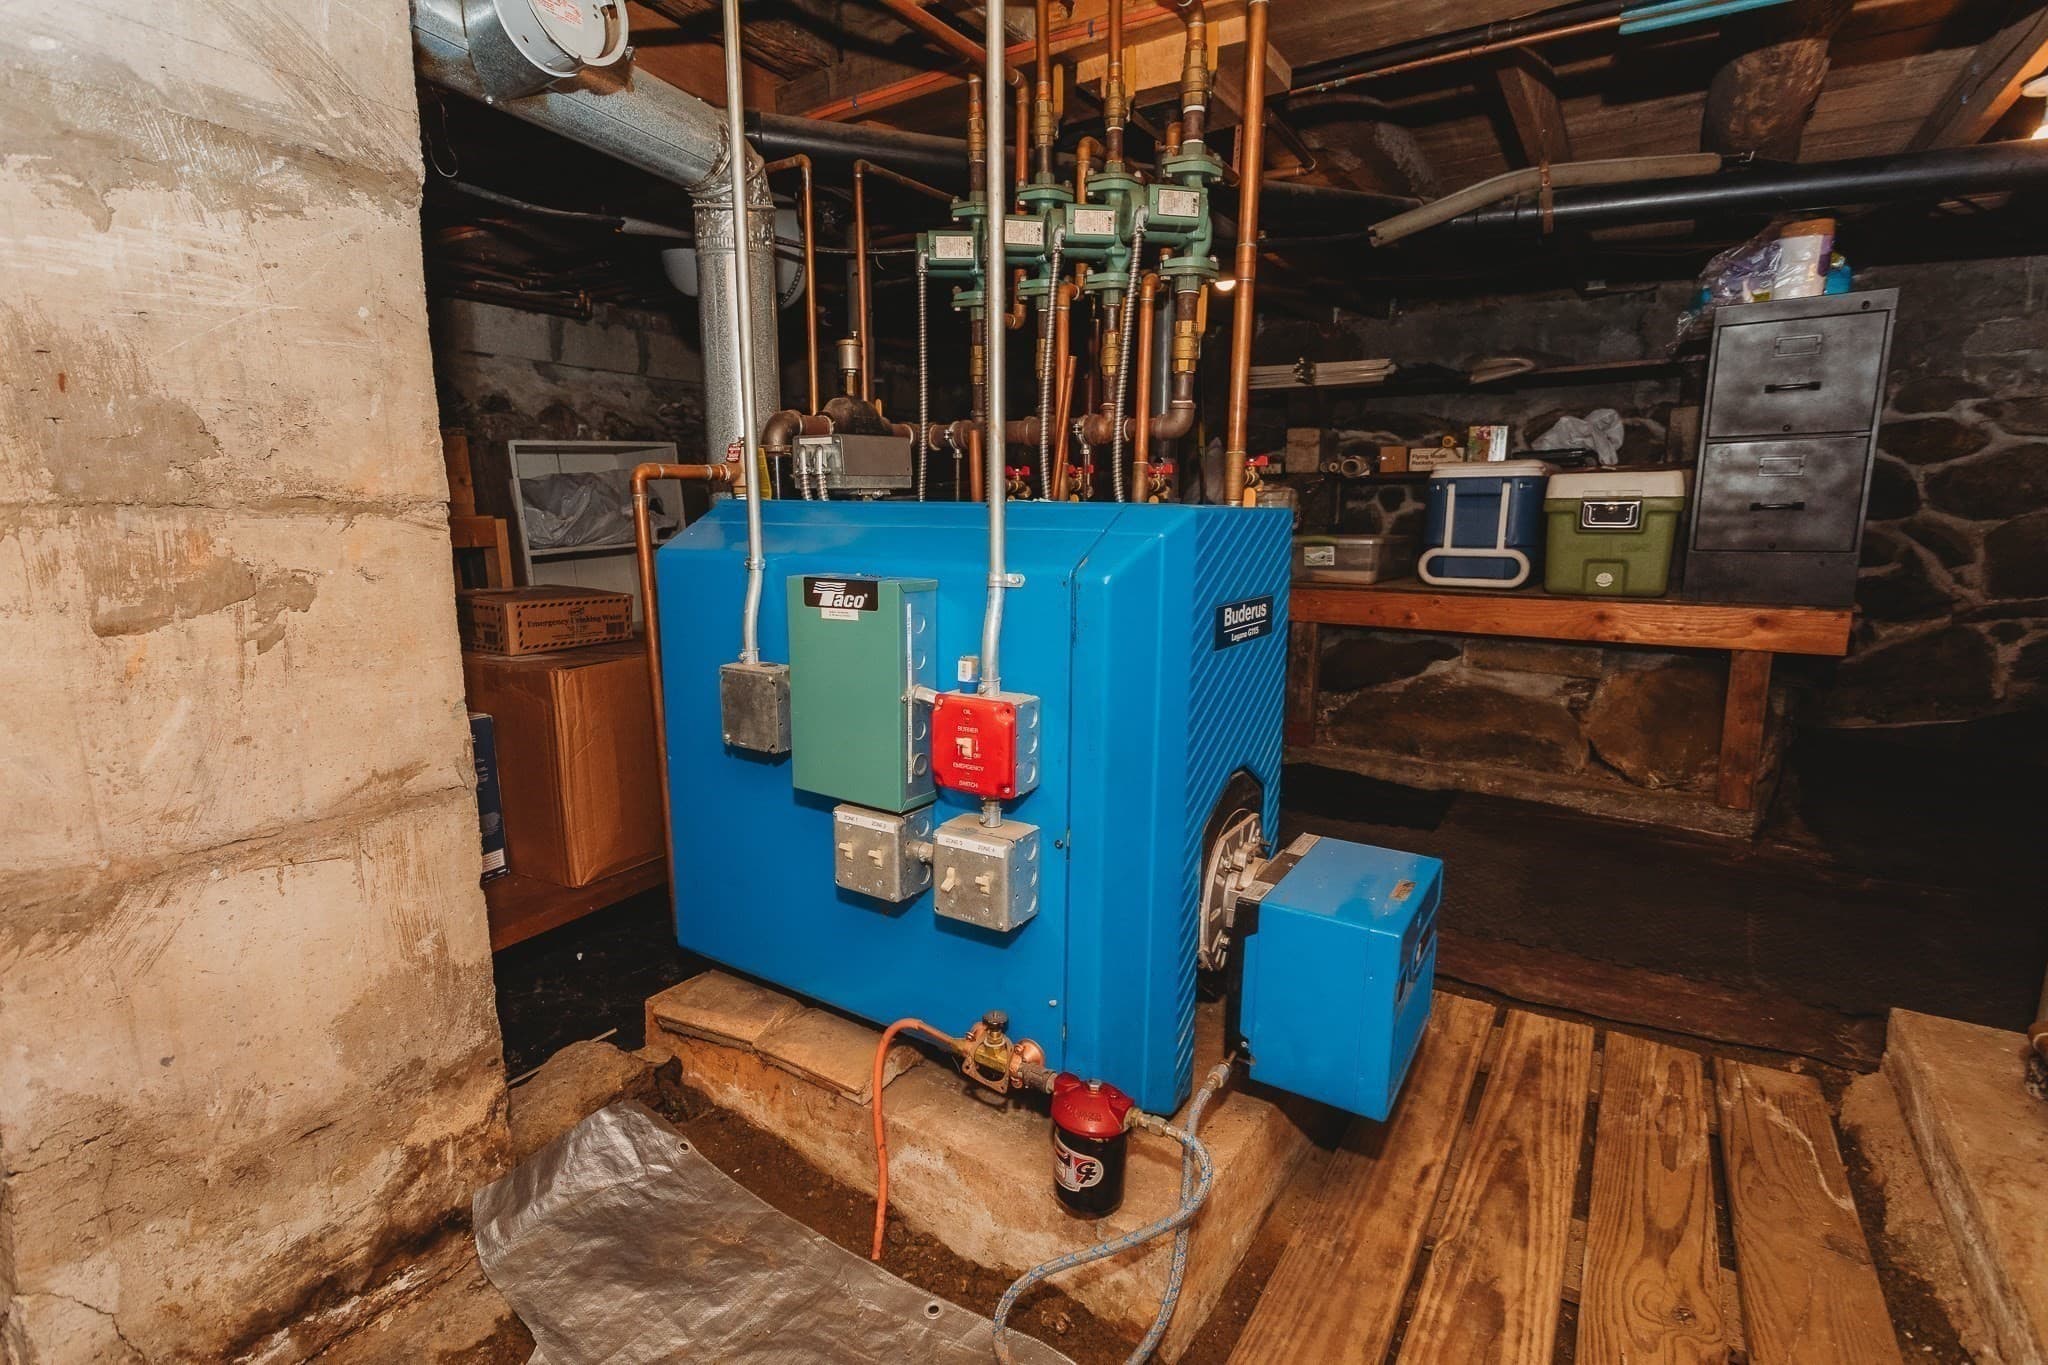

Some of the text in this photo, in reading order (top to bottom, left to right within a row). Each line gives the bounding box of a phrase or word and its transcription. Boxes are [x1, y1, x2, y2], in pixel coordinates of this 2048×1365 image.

[1224, 603, 1267, 627] Buderus
[527, 618, 568, 629] Emergency
[957, 725, 979, 734] BURNER
[952, 761, 985, 772] EMERGENCY
[958, 779, 979, 789] SWITCH
